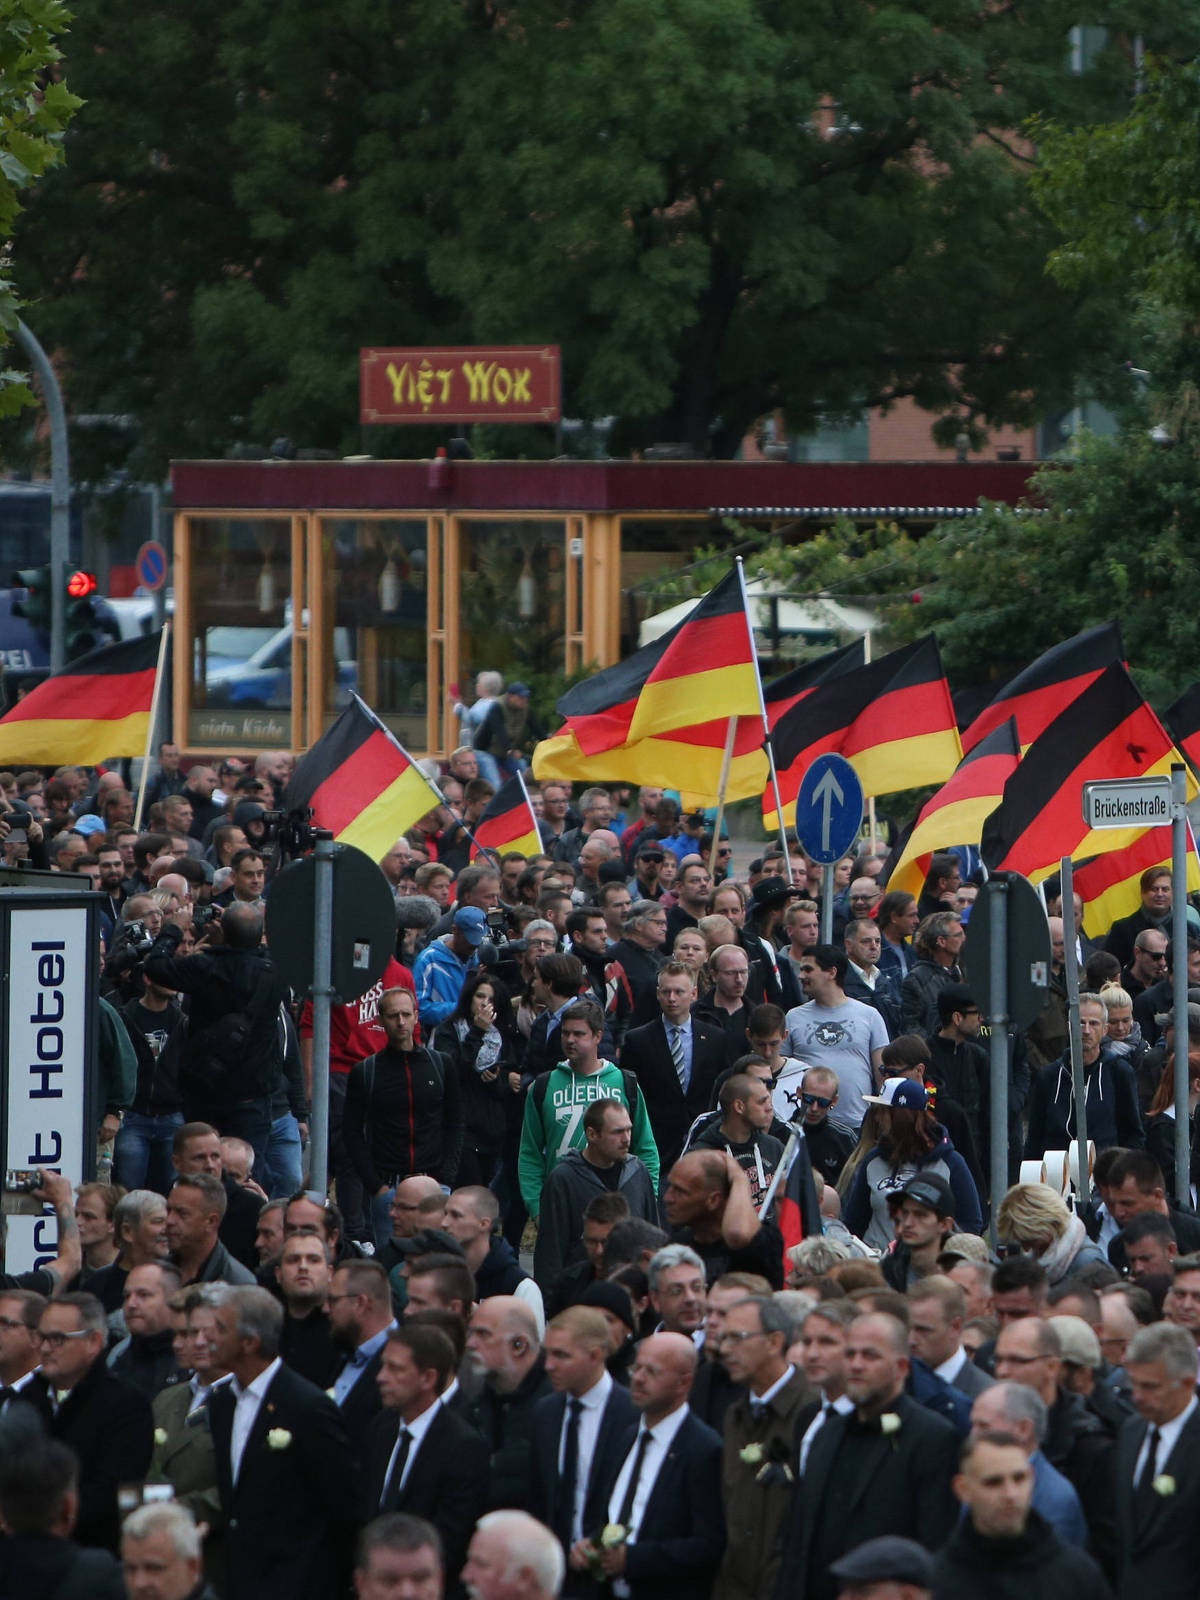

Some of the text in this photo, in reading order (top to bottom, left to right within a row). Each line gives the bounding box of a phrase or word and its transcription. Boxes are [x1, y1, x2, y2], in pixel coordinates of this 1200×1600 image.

[1094, 795, 1166, 818] Brückenstraße
[29, 942, 65, 1098] Hotel
[553, 1085, 622, 1107] QUEENS
